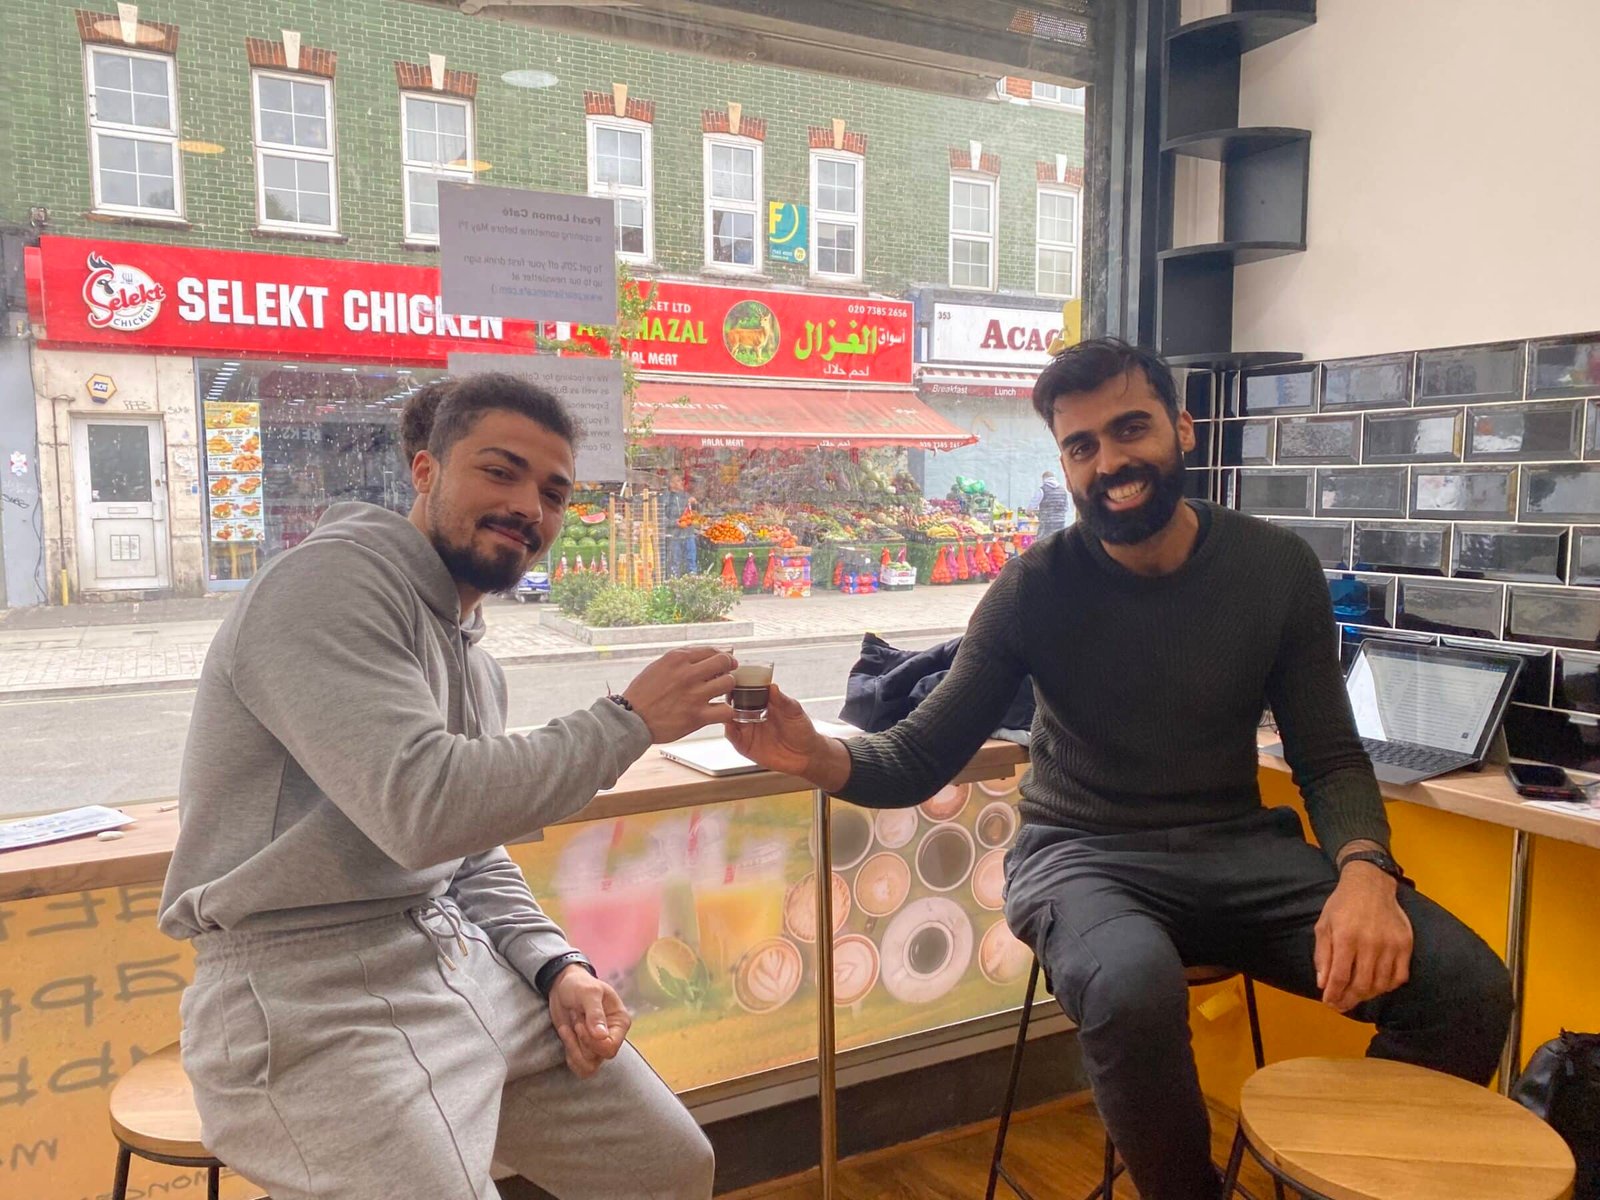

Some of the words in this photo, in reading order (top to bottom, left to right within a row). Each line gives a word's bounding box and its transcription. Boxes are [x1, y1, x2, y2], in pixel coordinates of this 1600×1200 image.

[177, 277, 329, 329] SELEKT
[672, 302, 692, 313] LTD
[113, 305, 155, 327] CHICKEN
[847, 304, 865, 314] 020
[867, 305, 887, 316] 7385
[888, 307, 908, 318] 2656
[937, 311, 951, 320] 353
[619, 316, 708, 345] HAZAL
[794, 318, 878, 361] الغزال
[648, 353, 679, 365] MEAT
[823, 363, 847, 377] حلال
[848, 365, 870, 378] لحم
[931, 384, 968, 395] Breakfast
[994, 386, 1017, 397] Lunch
[725, 439, 745, 447] MEAT
